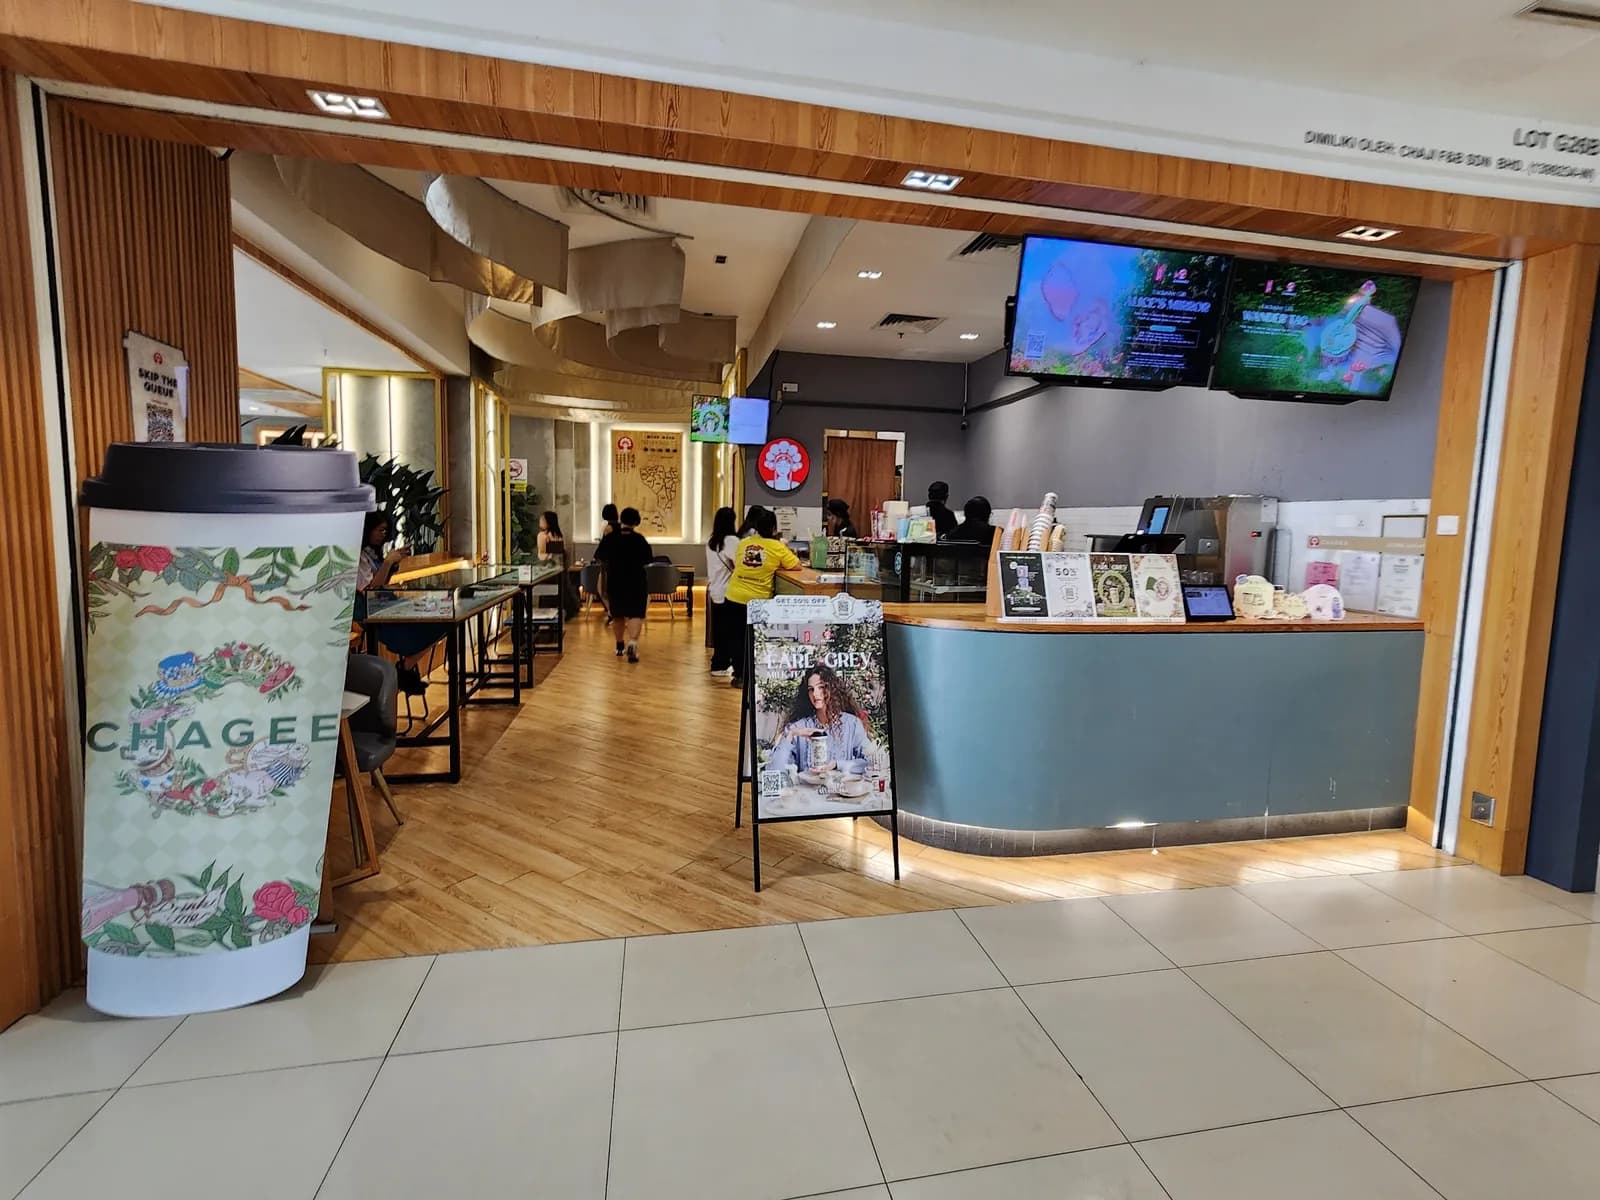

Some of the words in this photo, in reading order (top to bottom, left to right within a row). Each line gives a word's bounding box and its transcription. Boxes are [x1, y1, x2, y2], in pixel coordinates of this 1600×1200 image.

[1513, 127, 1551, 149] LOT
[138, 367, 160, 381] SKIP
[161, 375, 178, 389] THE
[143, 381, 174, 398] QUEUE
[766, 652, 815, 670] EARL
[824, 651, 873, 670] GREY
[86, 712, 339, 753] CHAGEE
